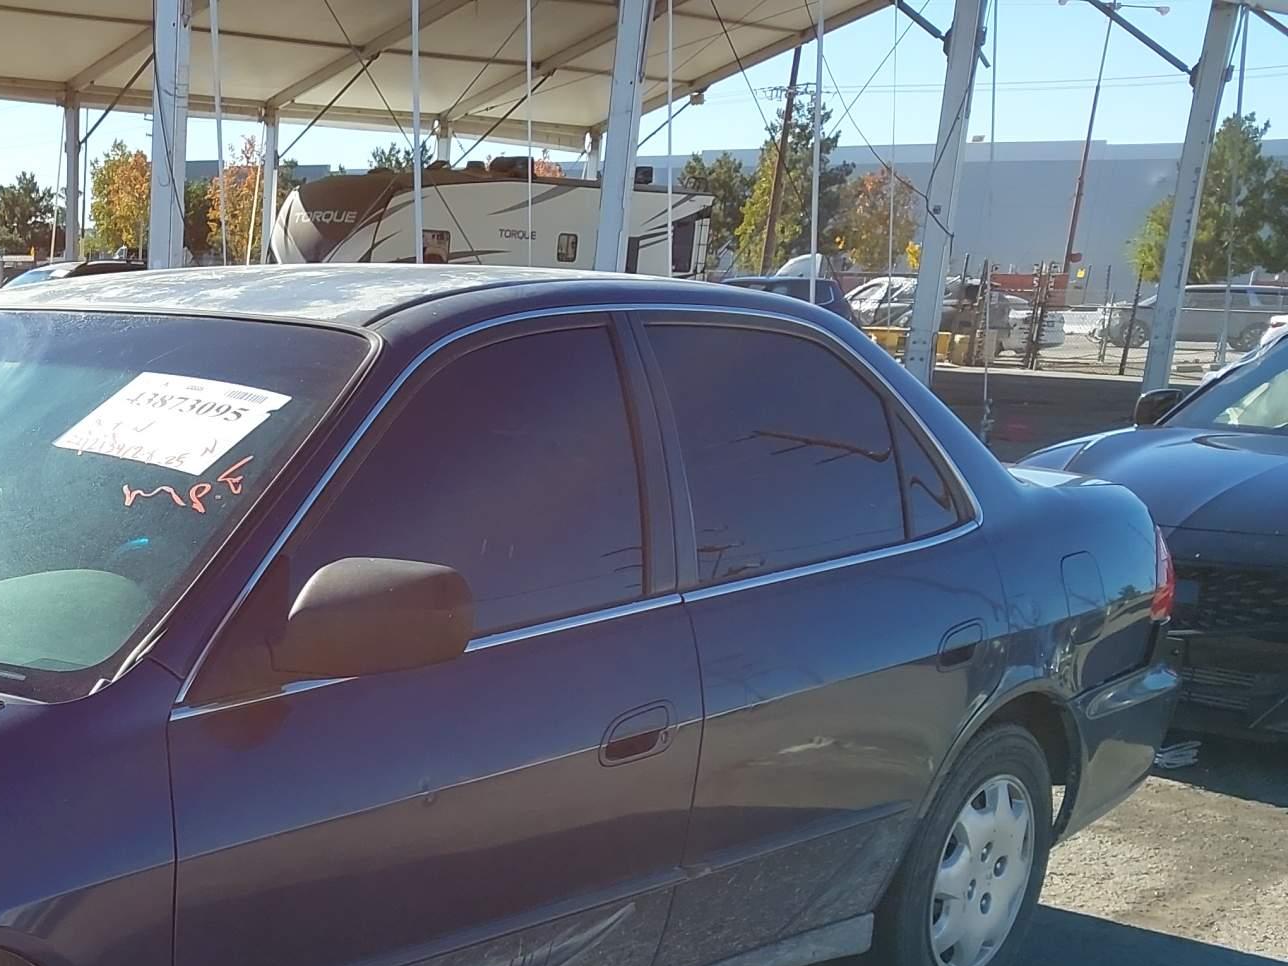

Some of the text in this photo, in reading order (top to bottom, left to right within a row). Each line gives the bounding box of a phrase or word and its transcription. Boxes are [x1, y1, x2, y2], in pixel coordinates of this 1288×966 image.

[294, 210, 358, 224] TORQUE
[498, 228, 537, 241] TORQUE
[126, 391, 250, 422] 43873095
